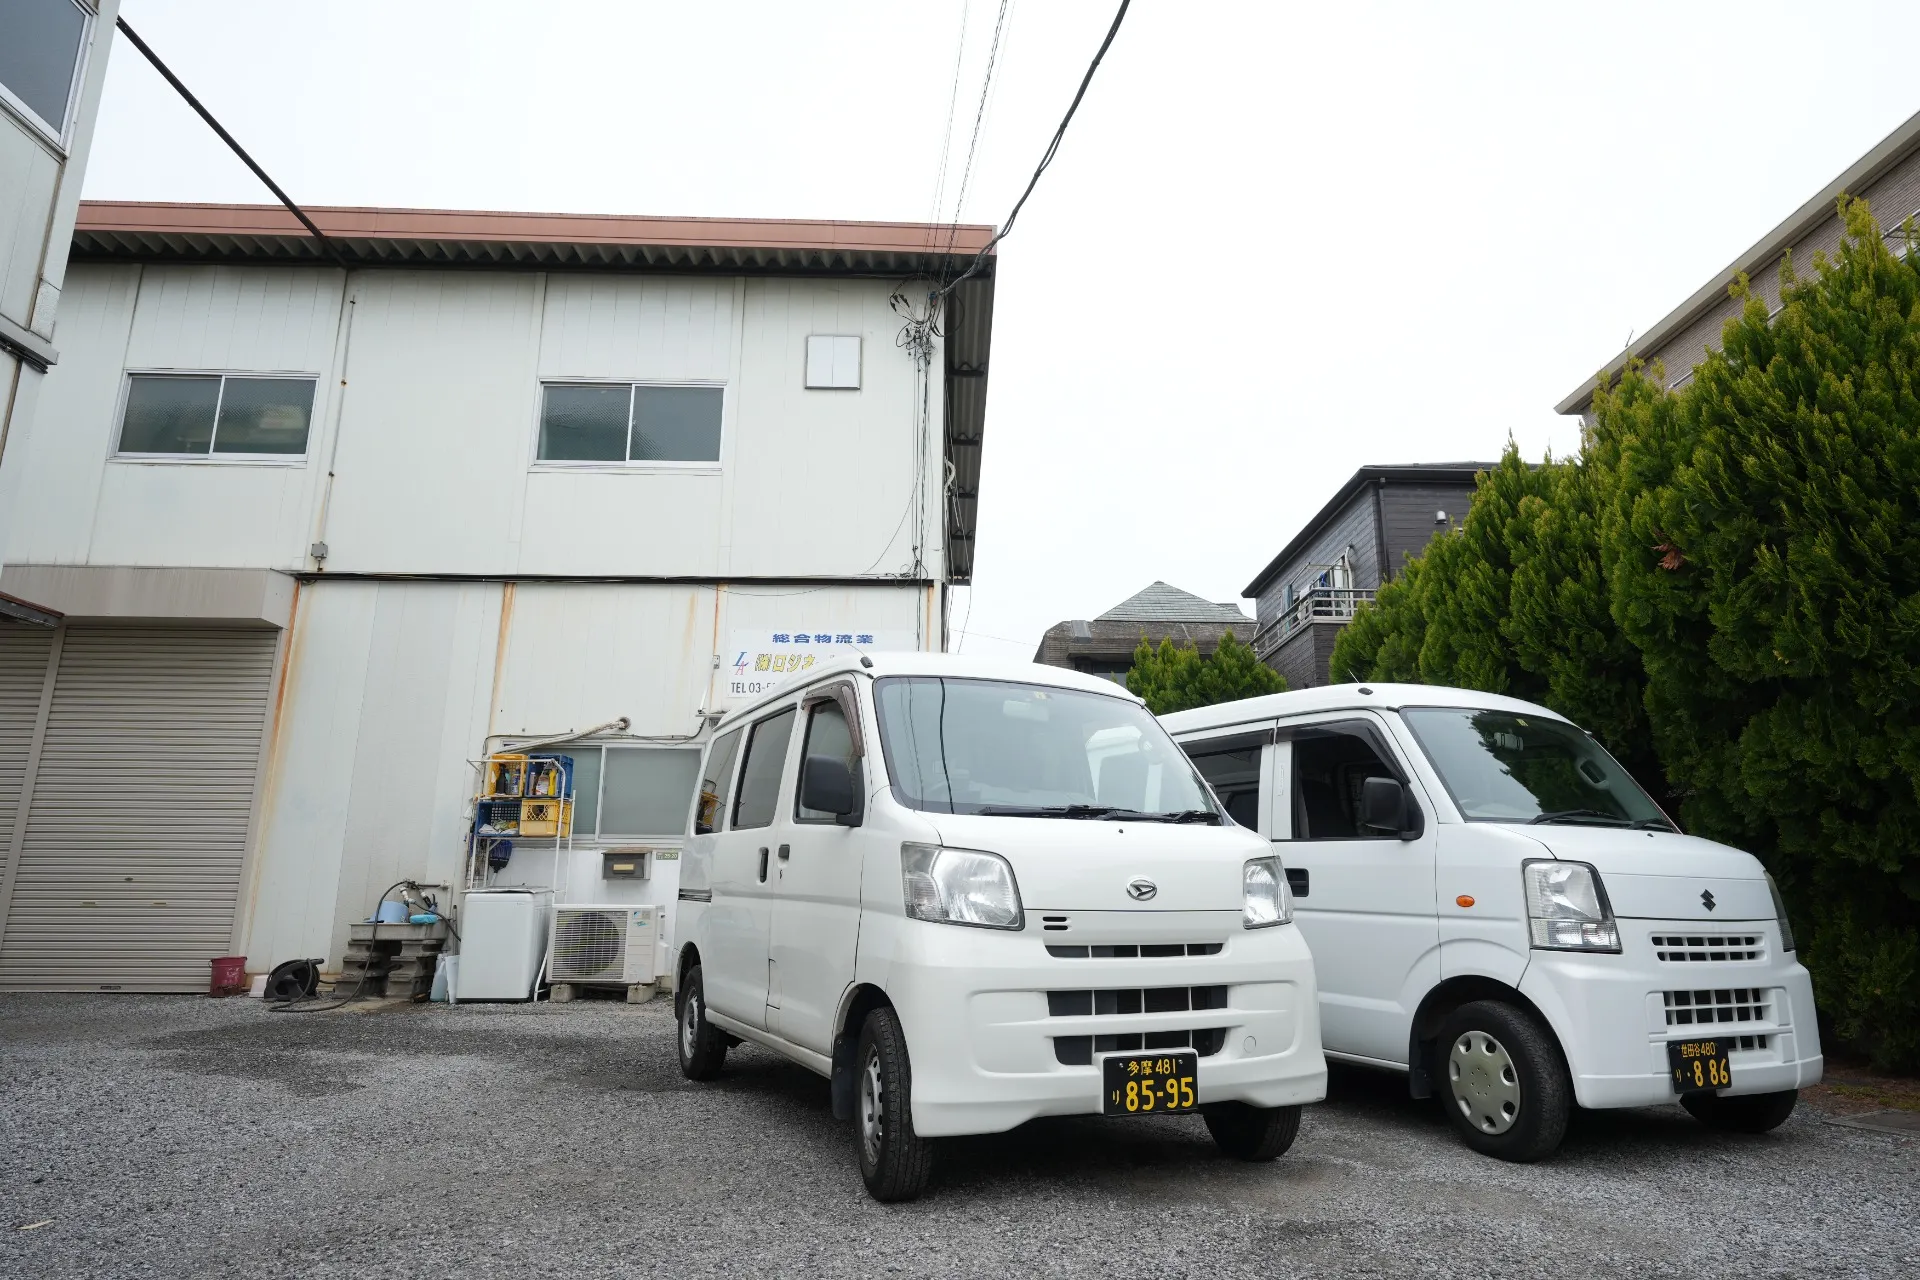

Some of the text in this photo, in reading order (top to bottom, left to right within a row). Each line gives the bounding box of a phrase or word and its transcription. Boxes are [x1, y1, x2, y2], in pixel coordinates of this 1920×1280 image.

[772, 633, 874, 644] 総合物流業
[731, 682, 747, 693] TEL
[1127, 1058, 1176, 1076] 多摩 481
[1126, 1077, 1194, 1111] 85-95
